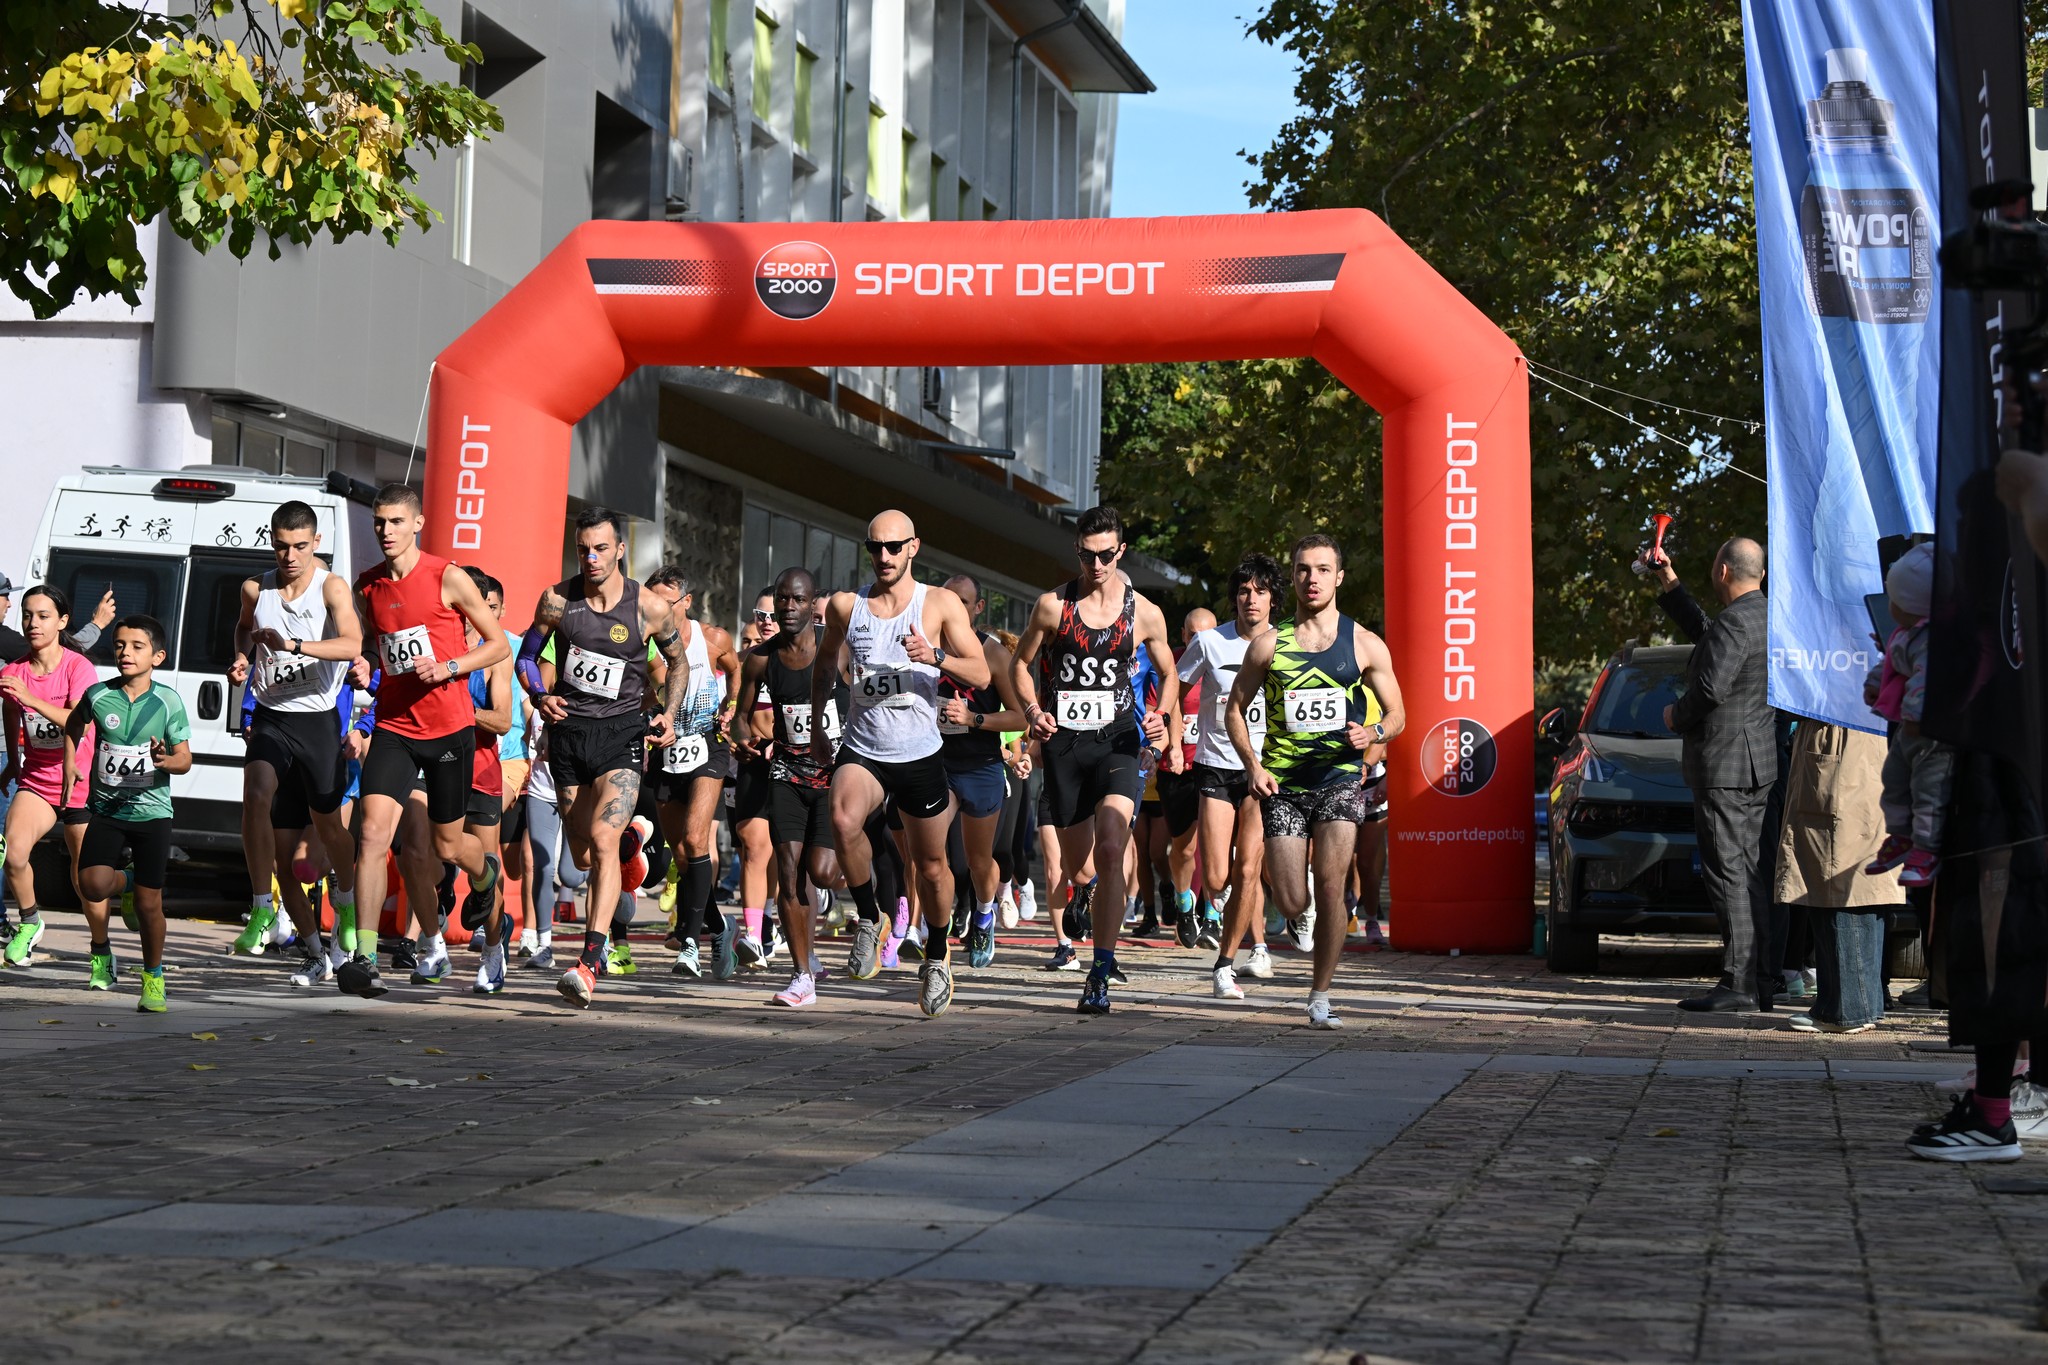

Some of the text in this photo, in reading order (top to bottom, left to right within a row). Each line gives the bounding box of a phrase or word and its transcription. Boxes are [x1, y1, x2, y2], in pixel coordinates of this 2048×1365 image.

[763, 262, 830, 277] SPORT
[854, 261, 1165, 296] SPORT DEPOT
[768, 279, 823, 294] 2000
[452, 415, 491, 550] DEPOT
[1444, 412, 1478, 702] SPORT DEPOT
[387, 639, 423, 664] 660
[273, 662, 307, 684] 631
[573, 660, 611, 686] 661
[1060, 653, 1118, 687] SSS
[863, 675, 901, 696] 651
[1067, 702, 1102, 720] 691
[1295, 700, 1337, 721] 655
[35, 722, 65, 739] 68
[669, 745, 700, 764] 529
[1443, 726, 1458, 789] SPORT
[1460, 731, 1474, 783] 2000
[105, 755, 145, 776] 664
[1397, 826, 1525, 845] www.sportdepot.bg
